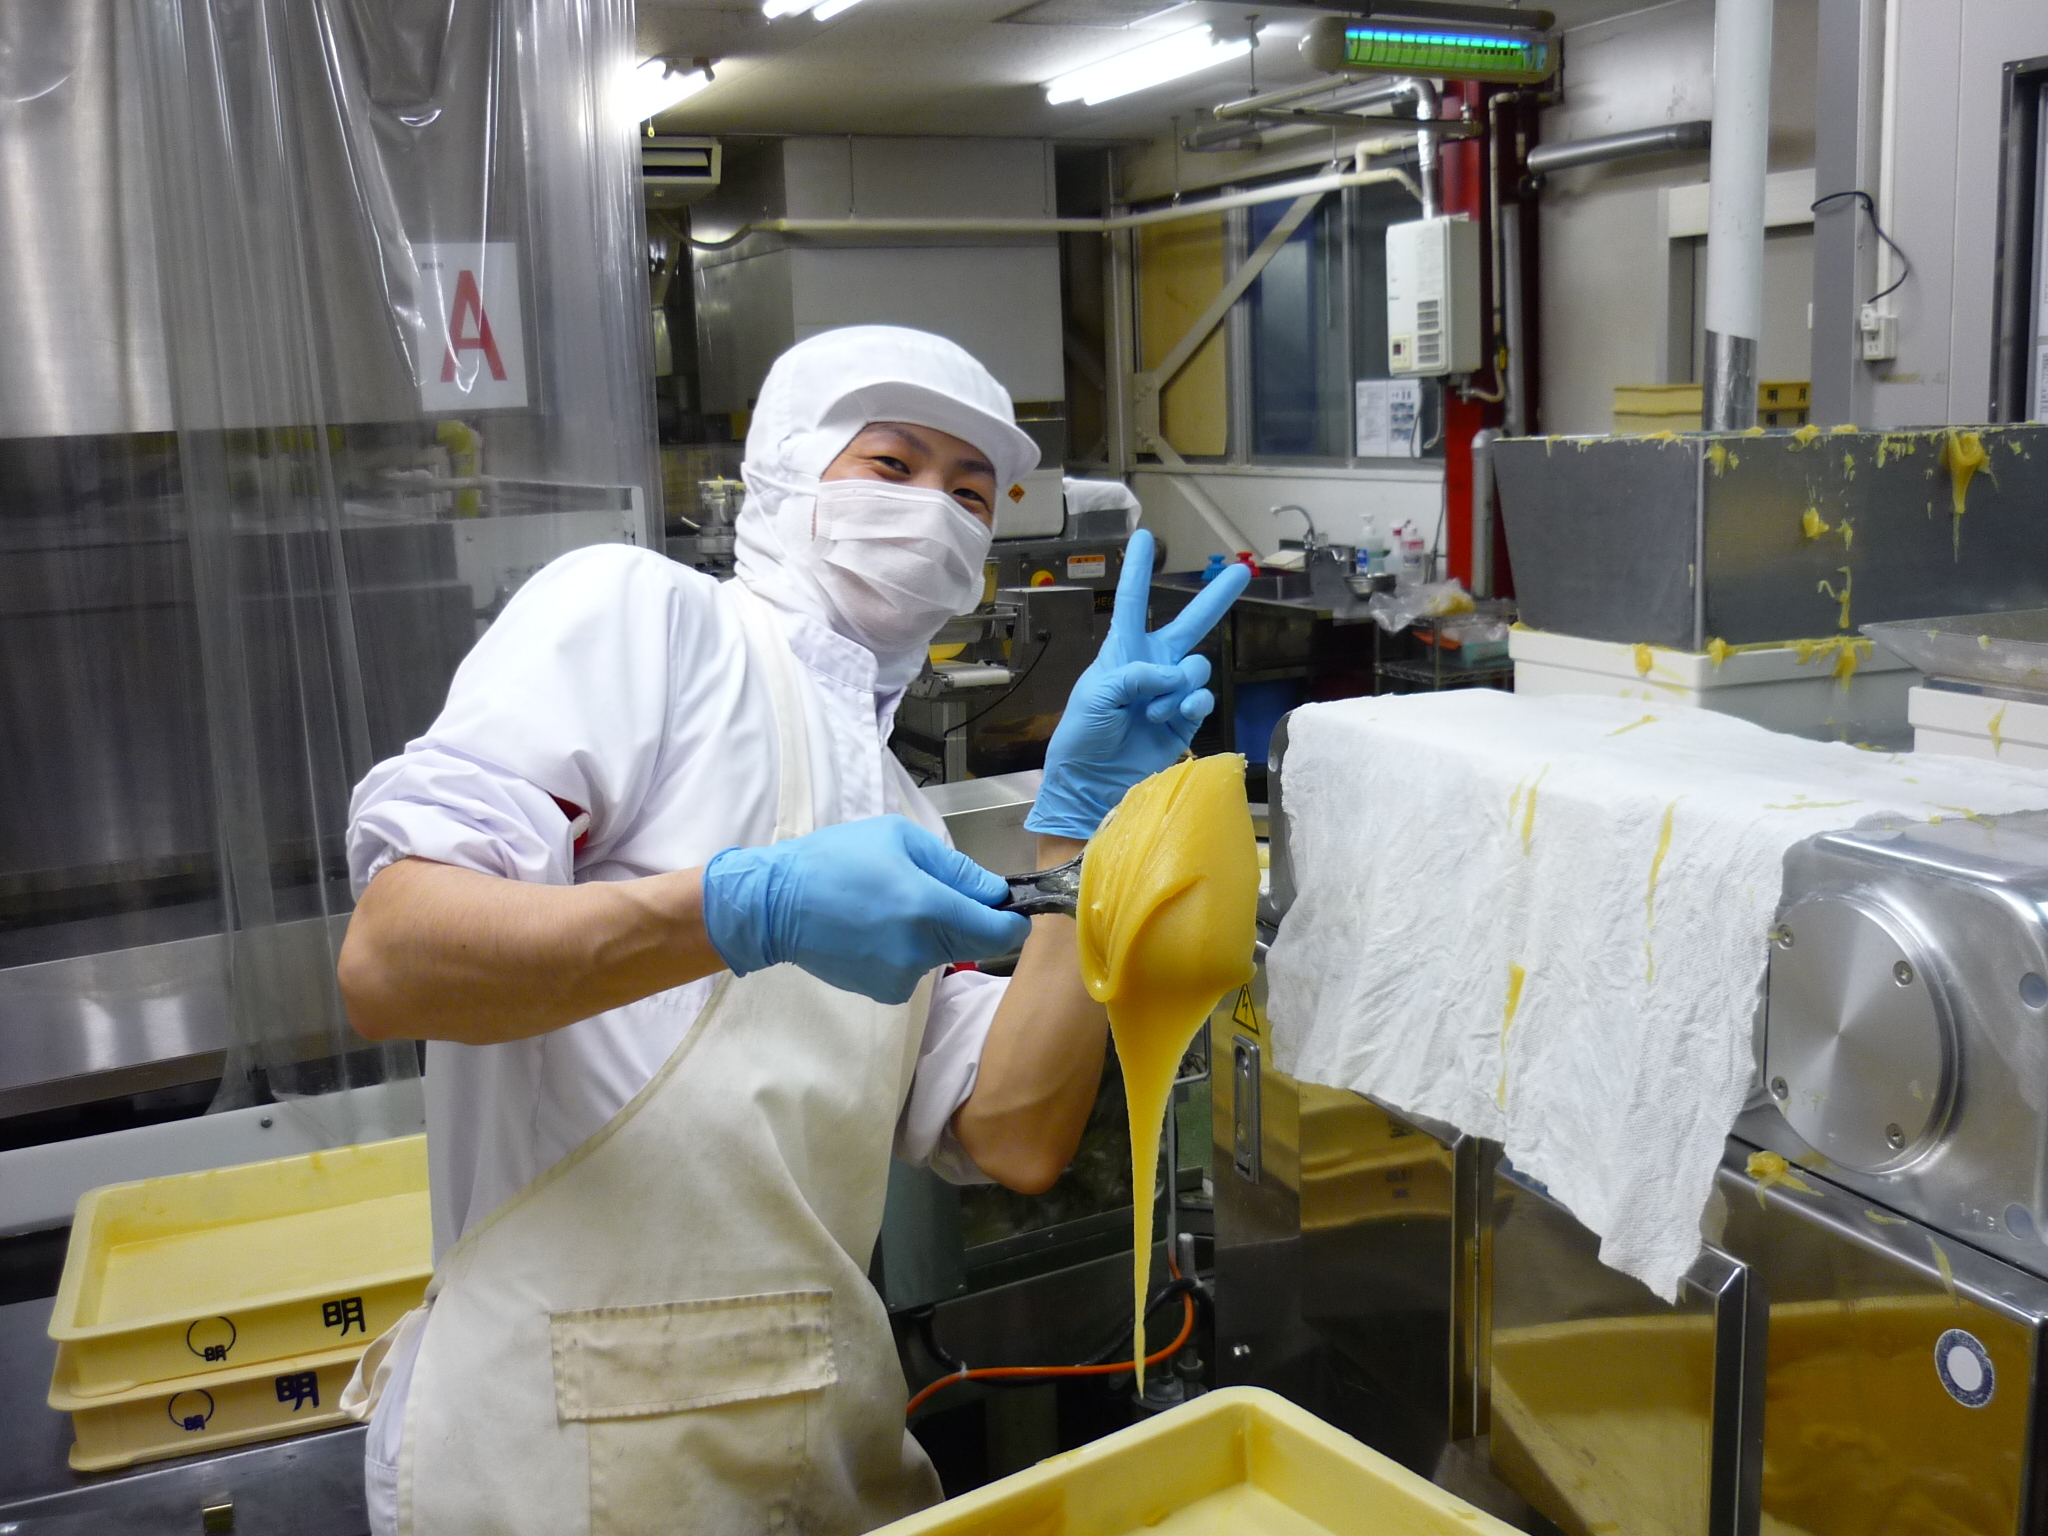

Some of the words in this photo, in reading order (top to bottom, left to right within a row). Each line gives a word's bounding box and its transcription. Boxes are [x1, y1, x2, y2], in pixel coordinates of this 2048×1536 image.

[440, 269, 508, 383] A
[322, 1296, 366, 1337] 明
[275, 1371, 320, 1412] 明
